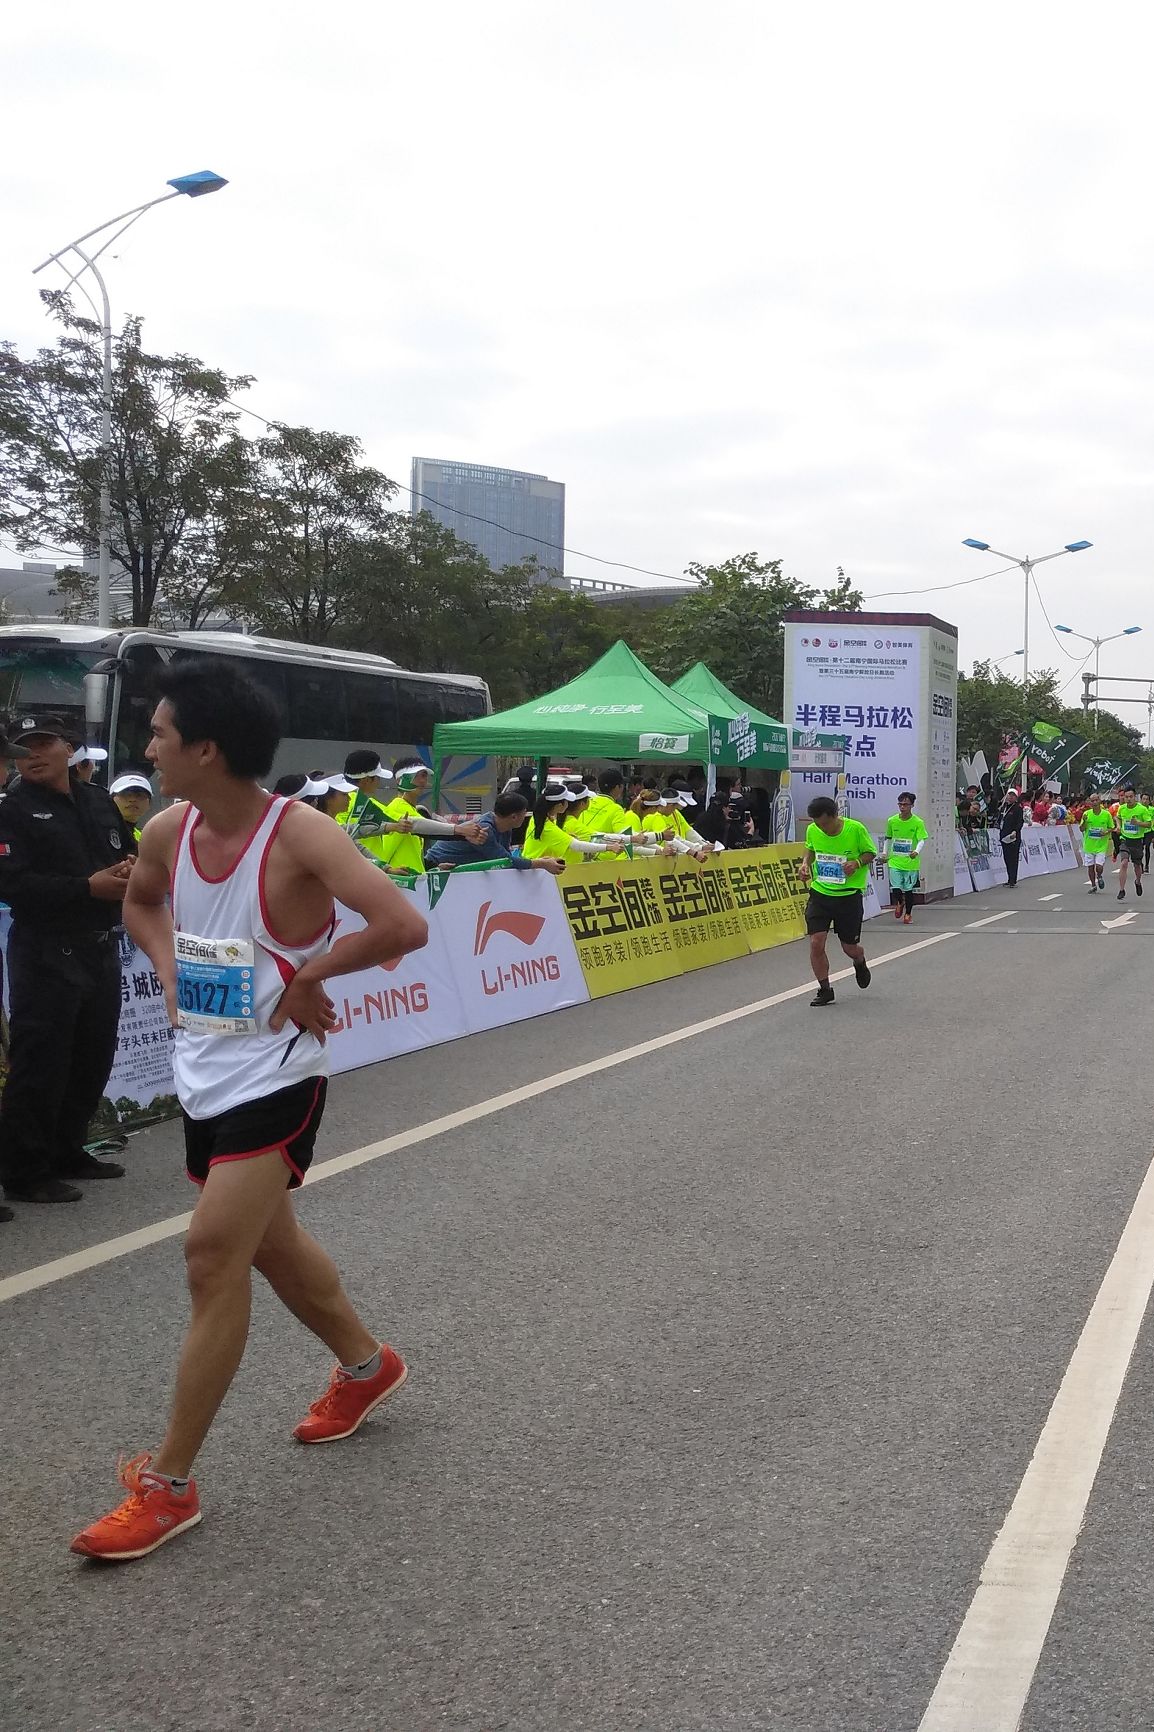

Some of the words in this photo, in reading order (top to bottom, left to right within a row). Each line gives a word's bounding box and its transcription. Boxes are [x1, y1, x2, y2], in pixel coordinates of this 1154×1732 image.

[795, 703, 914, 730] 半程马拉松
[802, 772, 832, 784] Half
[480, 955, 561, 996] LI-NING
